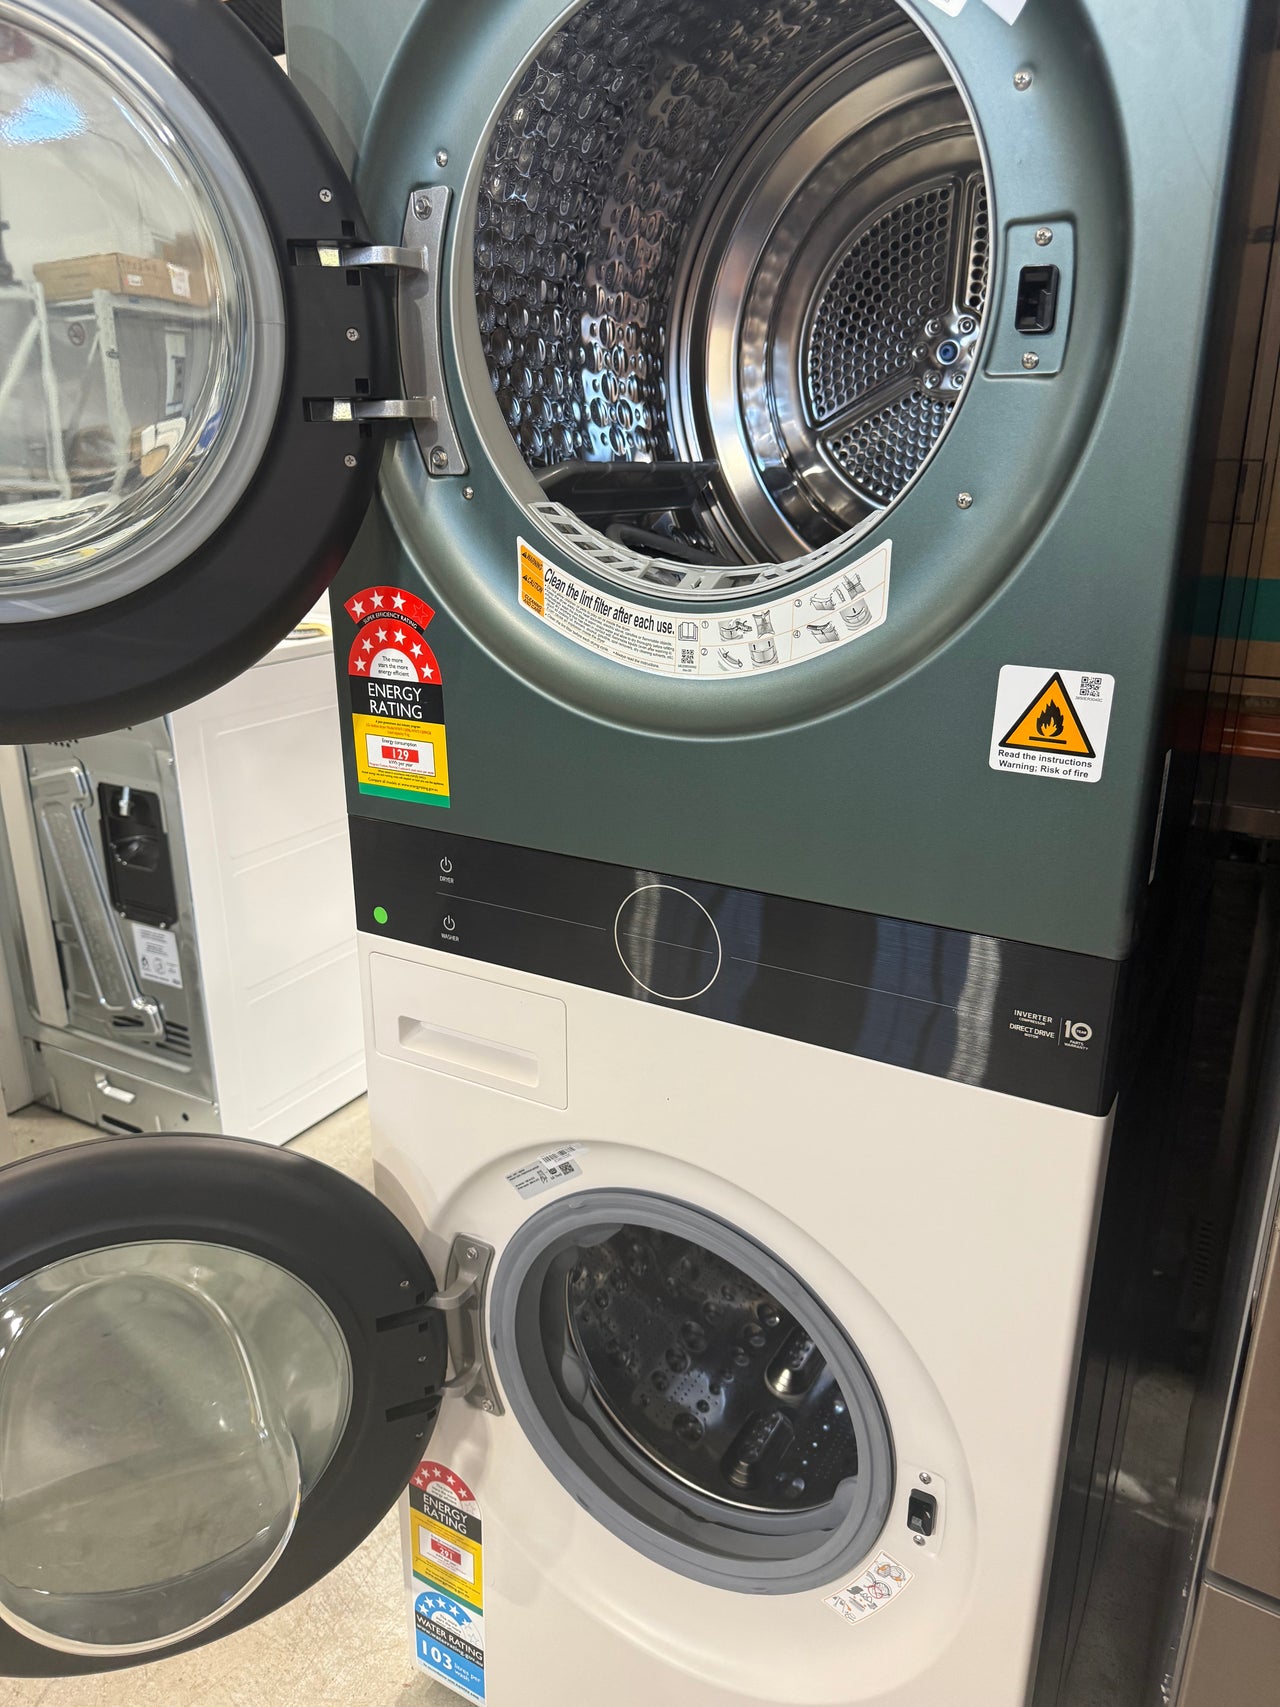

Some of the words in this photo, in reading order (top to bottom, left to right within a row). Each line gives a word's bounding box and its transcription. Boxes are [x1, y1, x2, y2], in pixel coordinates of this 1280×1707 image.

[527, 554, 542, 570] WARNING
[528, 577, 542, 593] CAUTION
[525, 594, 542, 610] CLEANING
[545, 568, 566, 593] Clean
[566, 583, 579, 600] the
[580, 590, 593, 609] lint
[593, 597, 612, 617] filter
[613, 606, 633, 624] after
[634, 615, 654, 631] each
[657, 621, 674, 634] use.
[363, 615, 375, 624] SUPER
[375, 612, 400, 620] EFFICIENCY
[400, 615, 418, 629] RATING
[368, 682, 421, 702] ENERGY
[369, 700, 422, 719] RATING
[392, 748, 409, 760] 129
[998, 750, 1020, 759] Read
[1023, 752, 1037, 760] the
[1039, 754, 1092, 768] instructions
[1040, 765, 1060, 774] Risk
[1074, 770, 1089, 778] fire
[441, 933, 460, 942] WASHER
[1014, 1009, 1052, 1023] INVERTER
[1009, 1023, 1034, 1033] DIRECT
[1034, 1028, 1055, 1038] DRIVE
[1064, 1020, 1092, 1041] 10
[1064, 1042, 1088, 1050] WARRANTY
[423, 1494, 468, 1523] ENERGY
[424, 1505, 467, 1534] RATING
[440, 1547, 453, 1560] 291
[416, 1614, 446, 1639] WATER
[448, 1633, 483, 1660] RATING
[422, 1640, 453, 1670] 103
